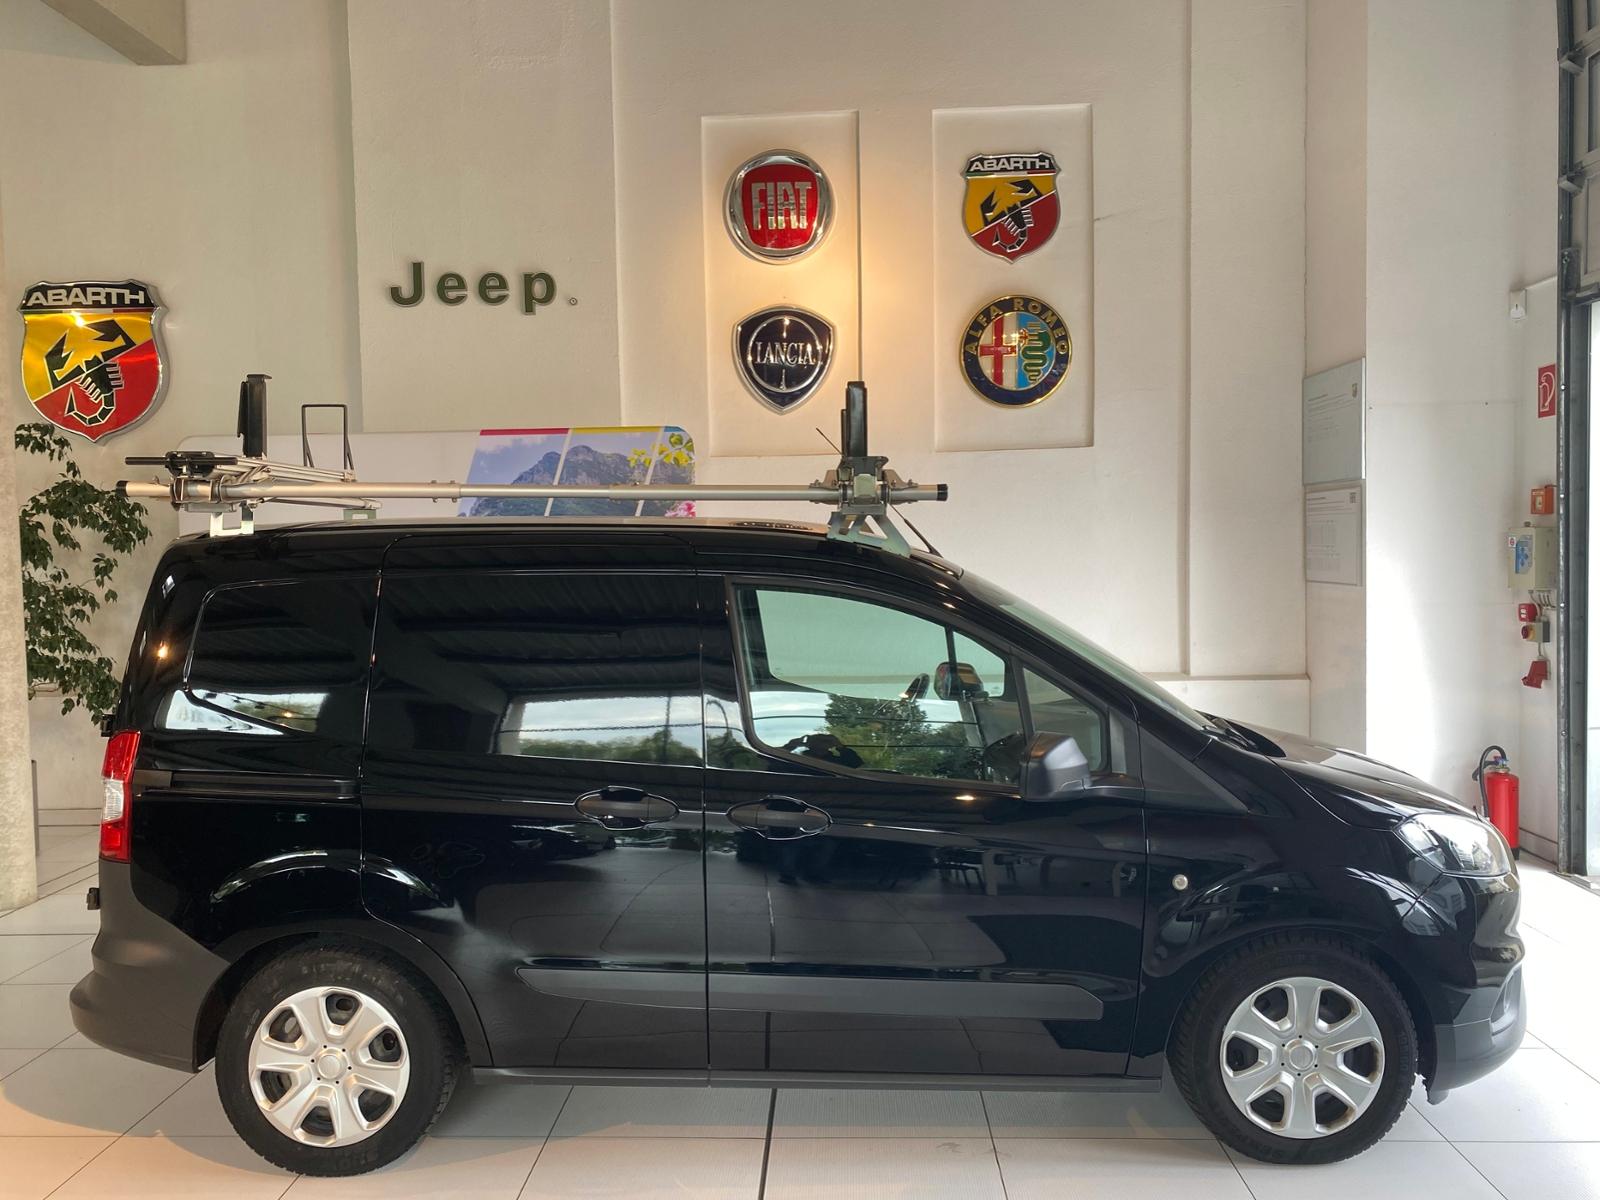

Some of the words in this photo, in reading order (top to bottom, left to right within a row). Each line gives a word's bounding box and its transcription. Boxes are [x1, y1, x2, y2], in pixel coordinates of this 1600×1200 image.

[969, 157, 1050, 172] ABARTH
[751, 181, 812, 230] FIAT
[26, 287, 145, 307] ABARTH
[390, 262, 557, 315] Jeep
[965, 305, 1003, 355] ALFA
[1013, 298, 1069, 354] ROMEO
[755, 341, 815, 367] LANCIA
